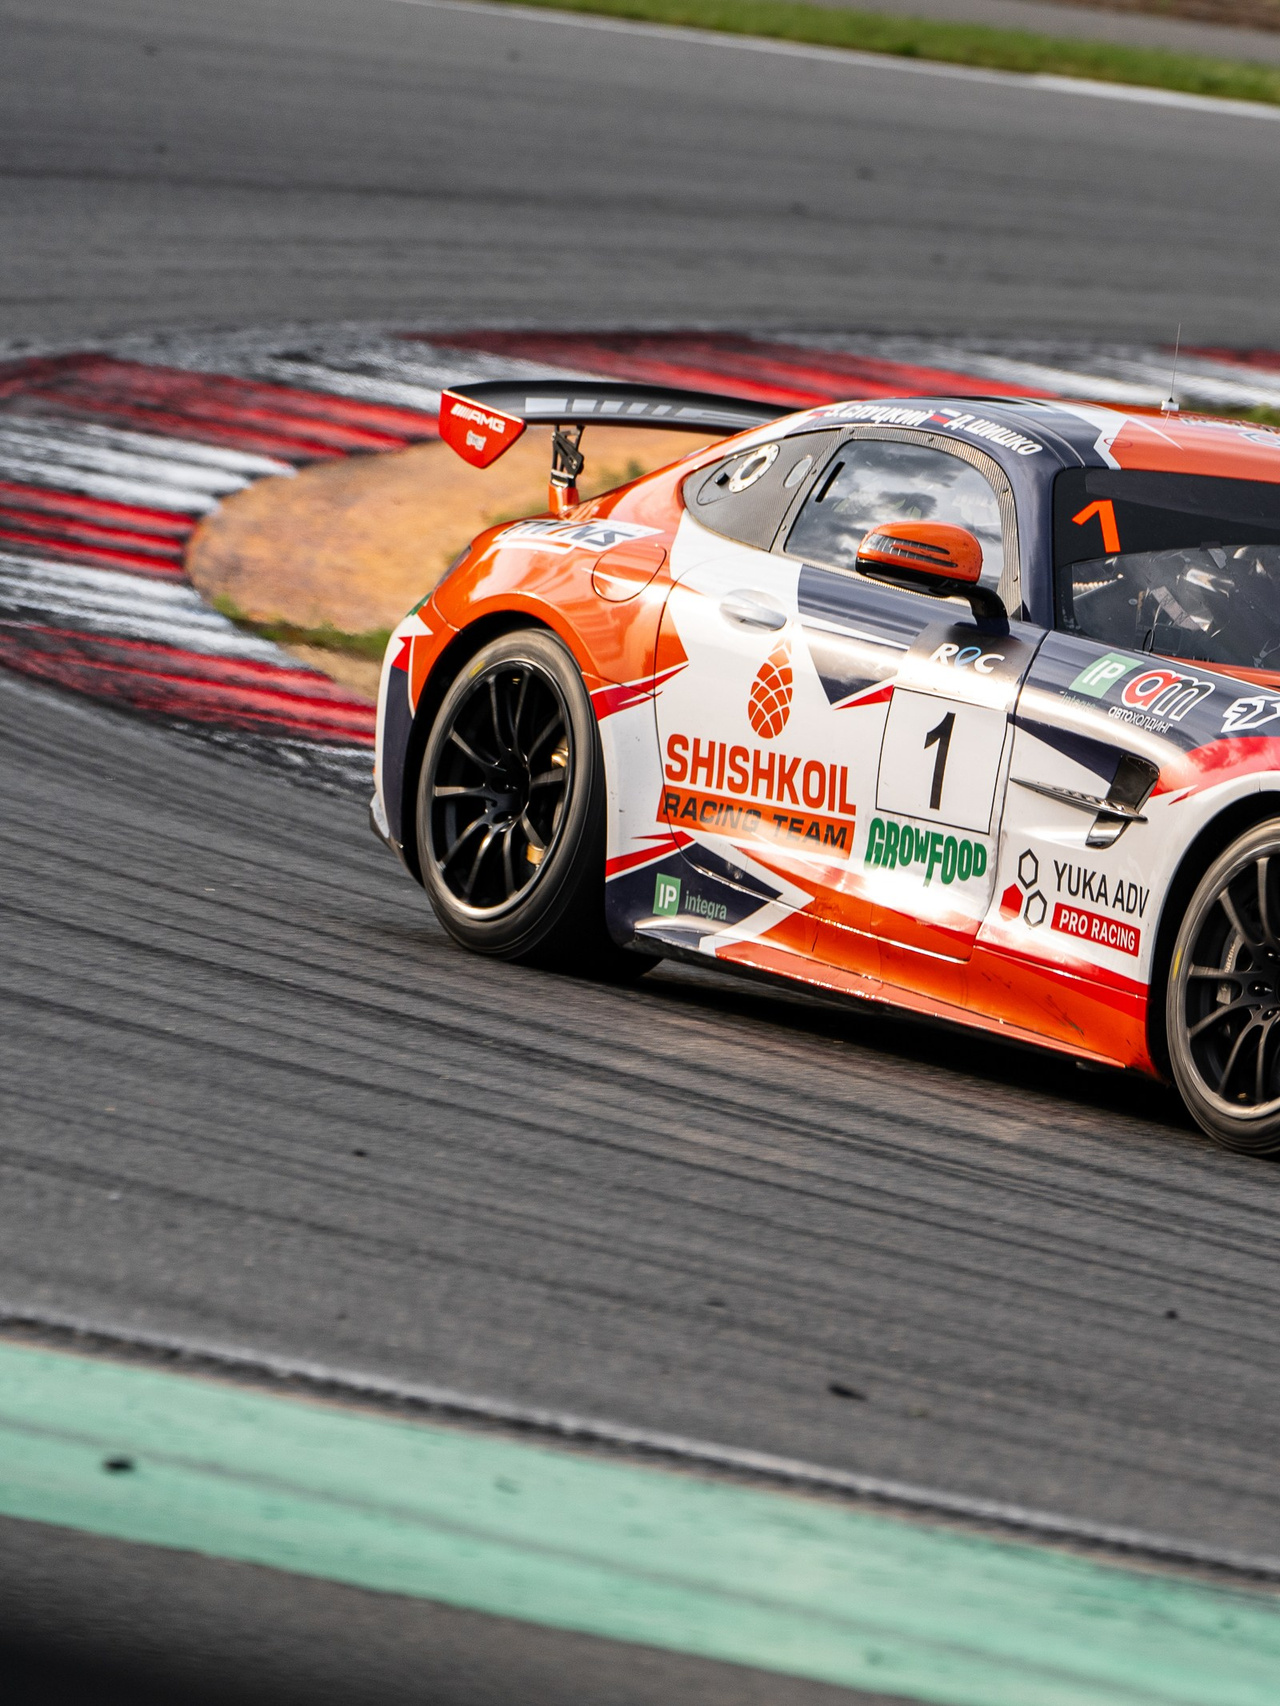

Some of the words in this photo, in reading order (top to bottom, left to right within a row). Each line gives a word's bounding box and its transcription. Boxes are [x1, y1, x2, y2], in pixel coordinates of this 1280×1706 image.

[1072, 499, 1121, 553] 1
[1083, 660, 1126, 686] IP
[665, 733, 857, 816] SHISHKOIL
[924, 711, 956, 811] 1
[663, 792, 762, 833] RACING
[773, 812, 848, 850] TEAM
[658, 883, 677, 909] IP
[684, 890, 727, 921] integra
[1053, 859, 1109, 907] YUKA
[1112, 879, 1150, 919] ADV
[1059, 908, 1088, 935] PRO
[1091, 917, 1135, 952] RACING
